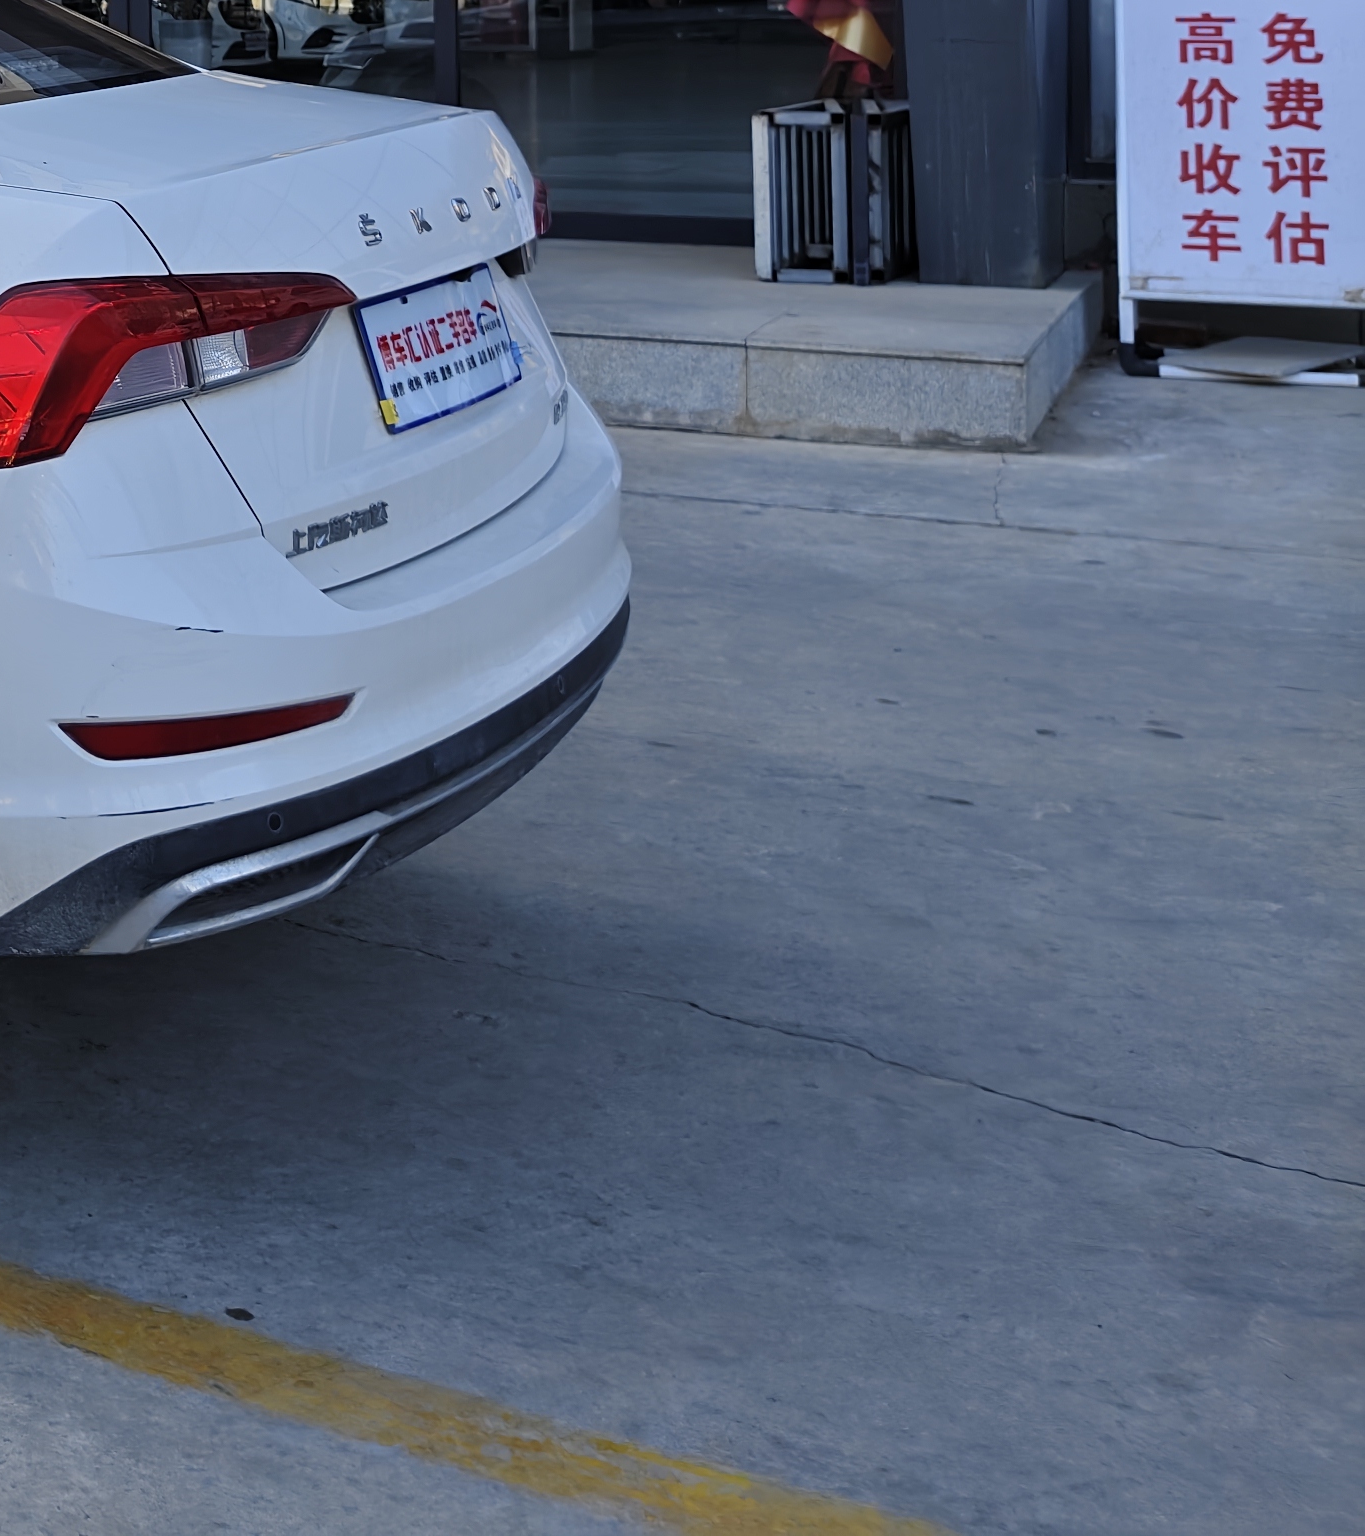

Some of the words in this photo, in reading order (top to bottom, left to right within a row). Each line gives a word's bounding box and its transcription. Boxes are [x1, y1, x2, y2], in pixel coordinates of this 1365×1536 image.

[1174, 14, 1244, 266] 高价收车
[1259, 9, 1330, 269] 免费评估
